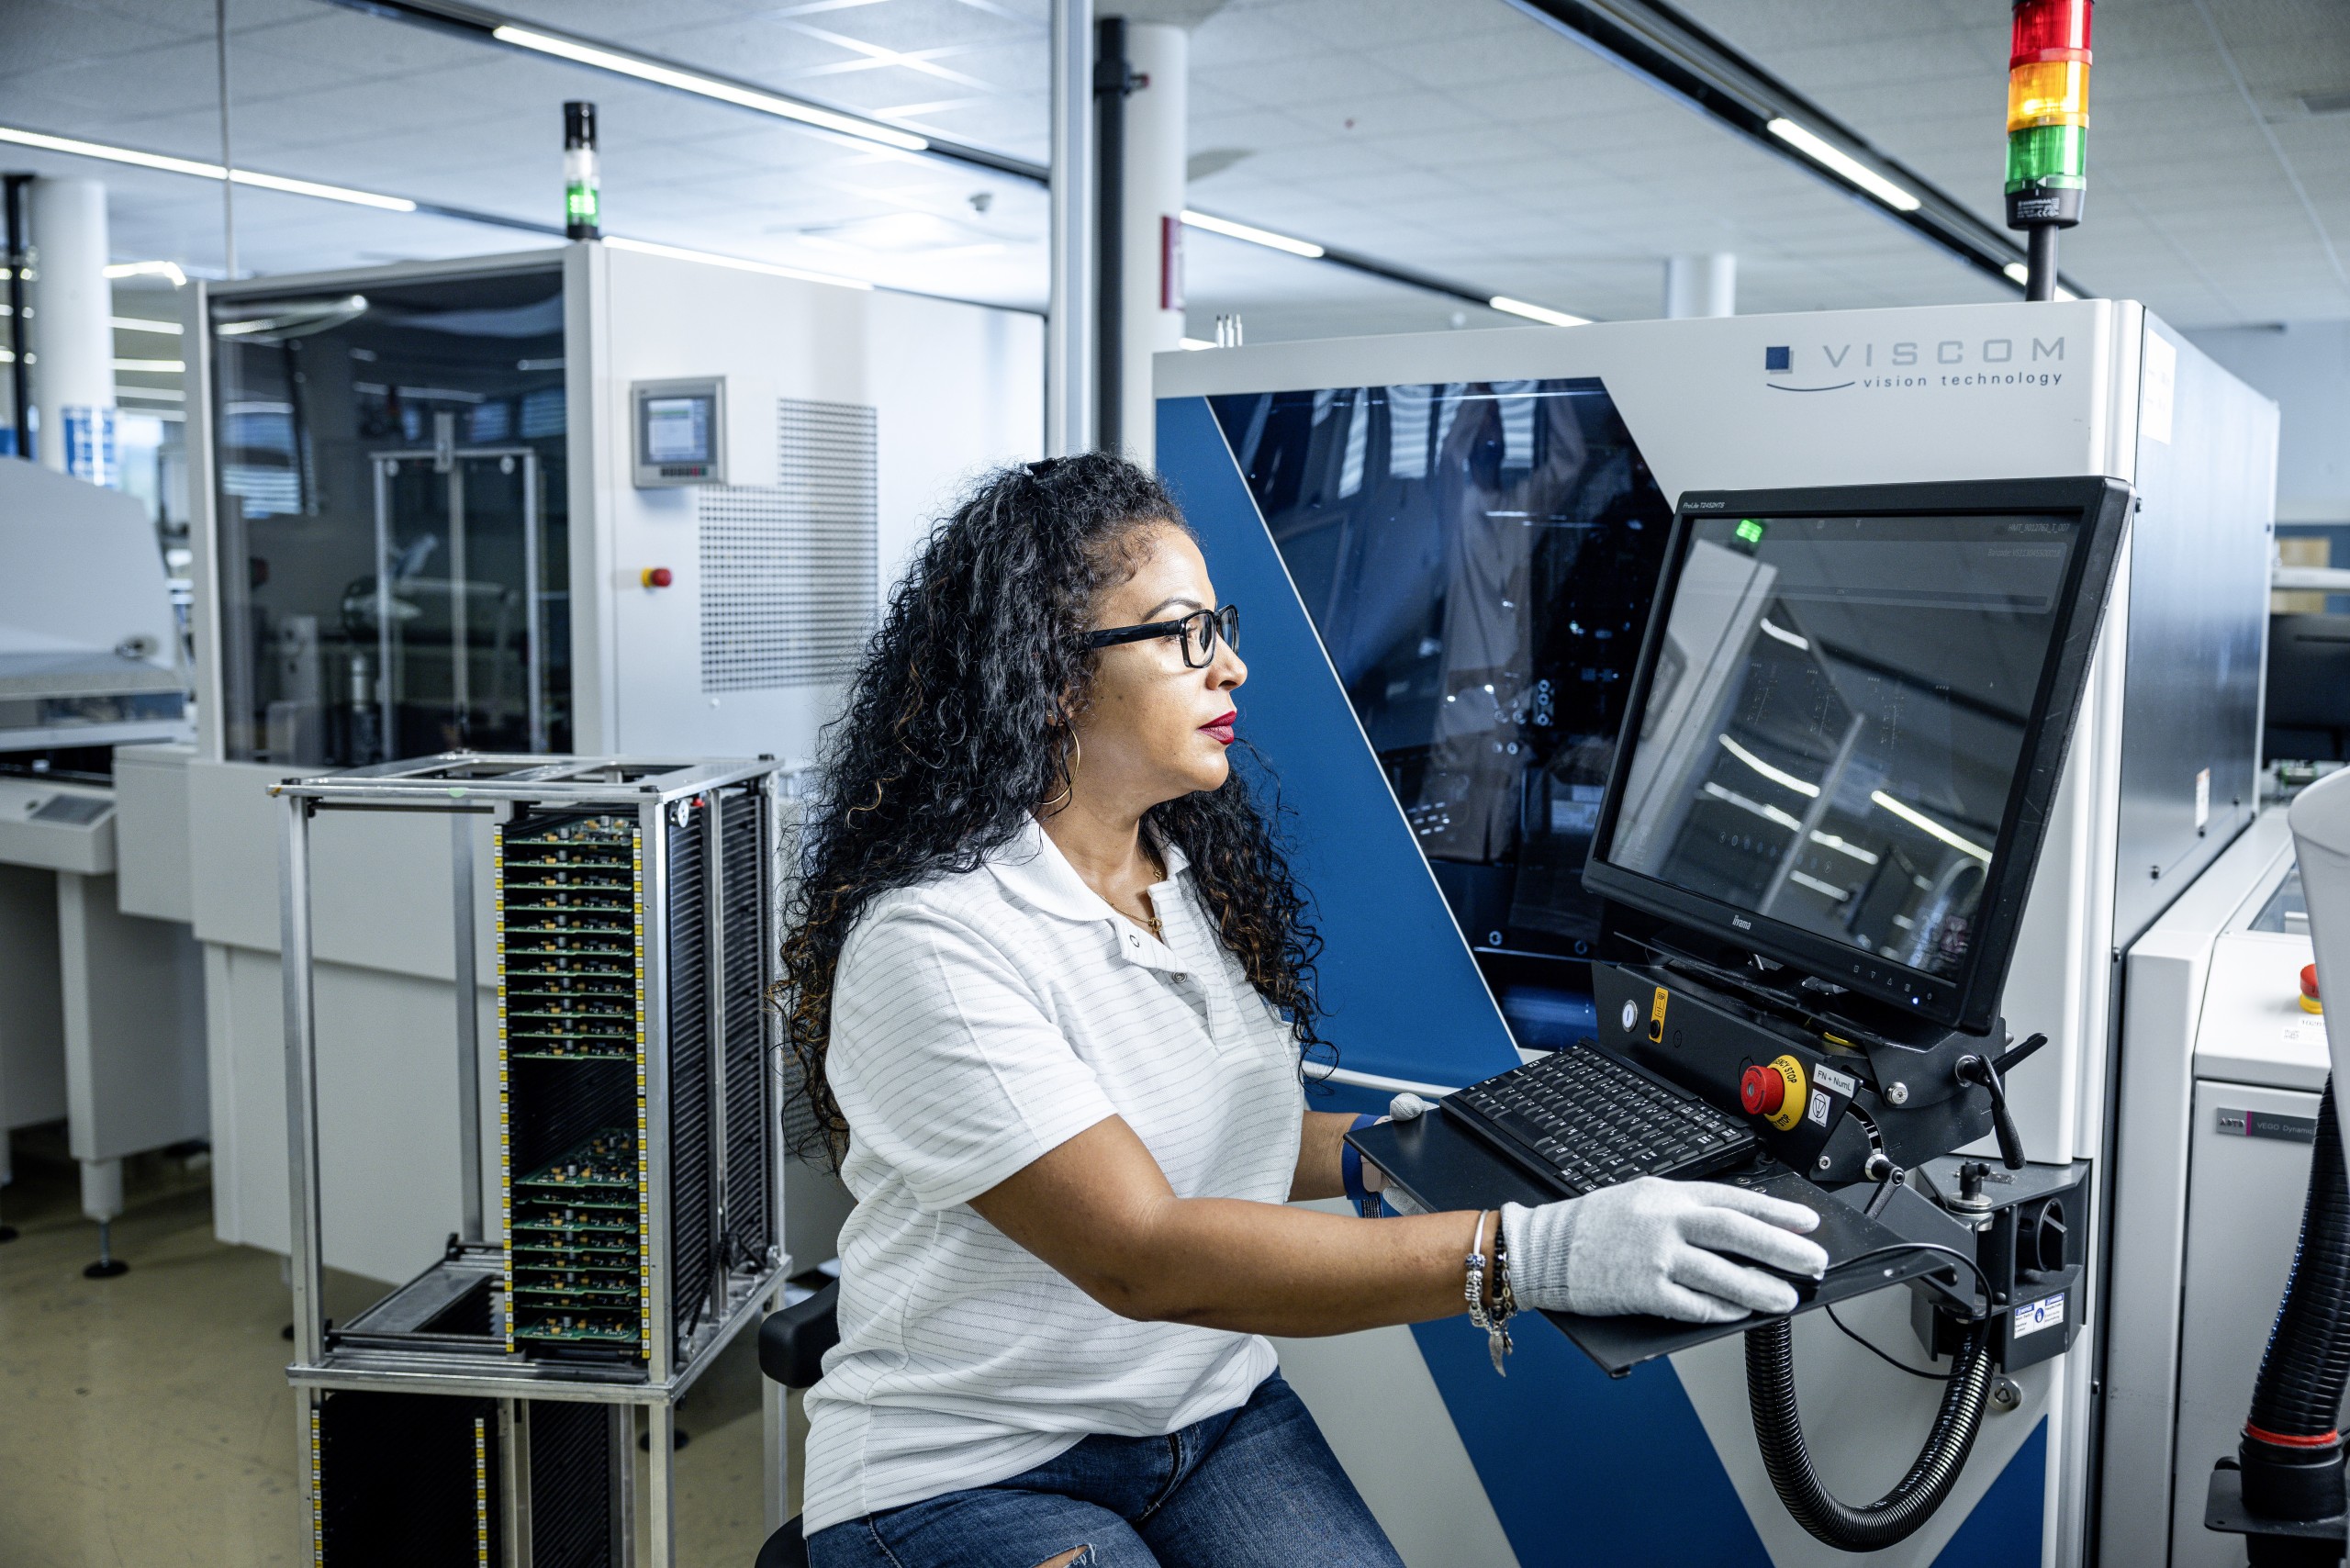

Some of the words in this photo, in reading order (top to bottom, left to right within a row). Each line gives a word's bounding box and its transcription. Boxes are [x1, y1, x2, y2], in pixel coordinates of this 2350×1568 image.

[1822, 336, 2065, 368] VISCOM
[1863, 375, 1927, 388] vision
[1941, 371, 2063, 386] technology
[1732, 914, 1751, 931] iiyama
[1784, 1067, 1797, 1083] STOP
[1818, 1070, 1828, 1081] FN
[1833, 1077, 1852, 1092] NumL
